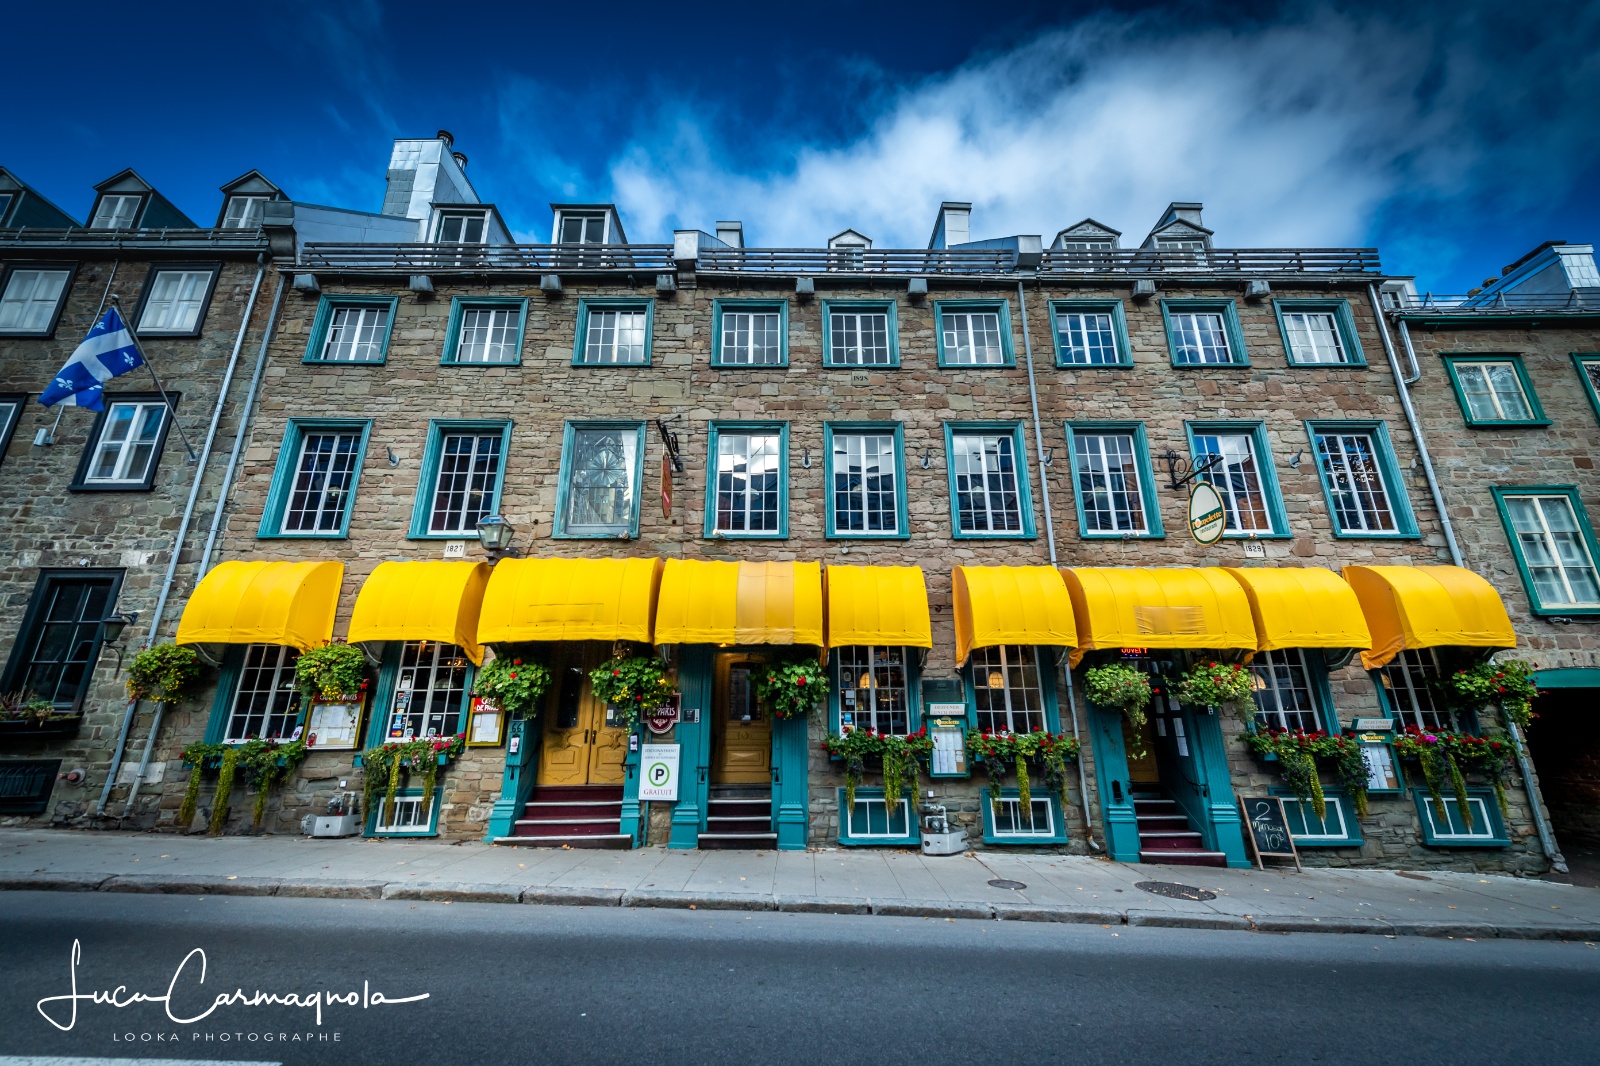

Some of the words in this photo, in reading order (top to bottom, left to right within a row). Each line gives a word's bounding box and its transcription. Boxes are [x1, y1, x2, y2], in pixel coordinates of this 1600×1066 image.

[657, 707, 676, 716] PARIS
[511, 722, 522, 733] 66
[655, 768, 665, 781] P
[643, 788, 673, 797] GRATUIT
[1256, 802, 1271, 820] 2
